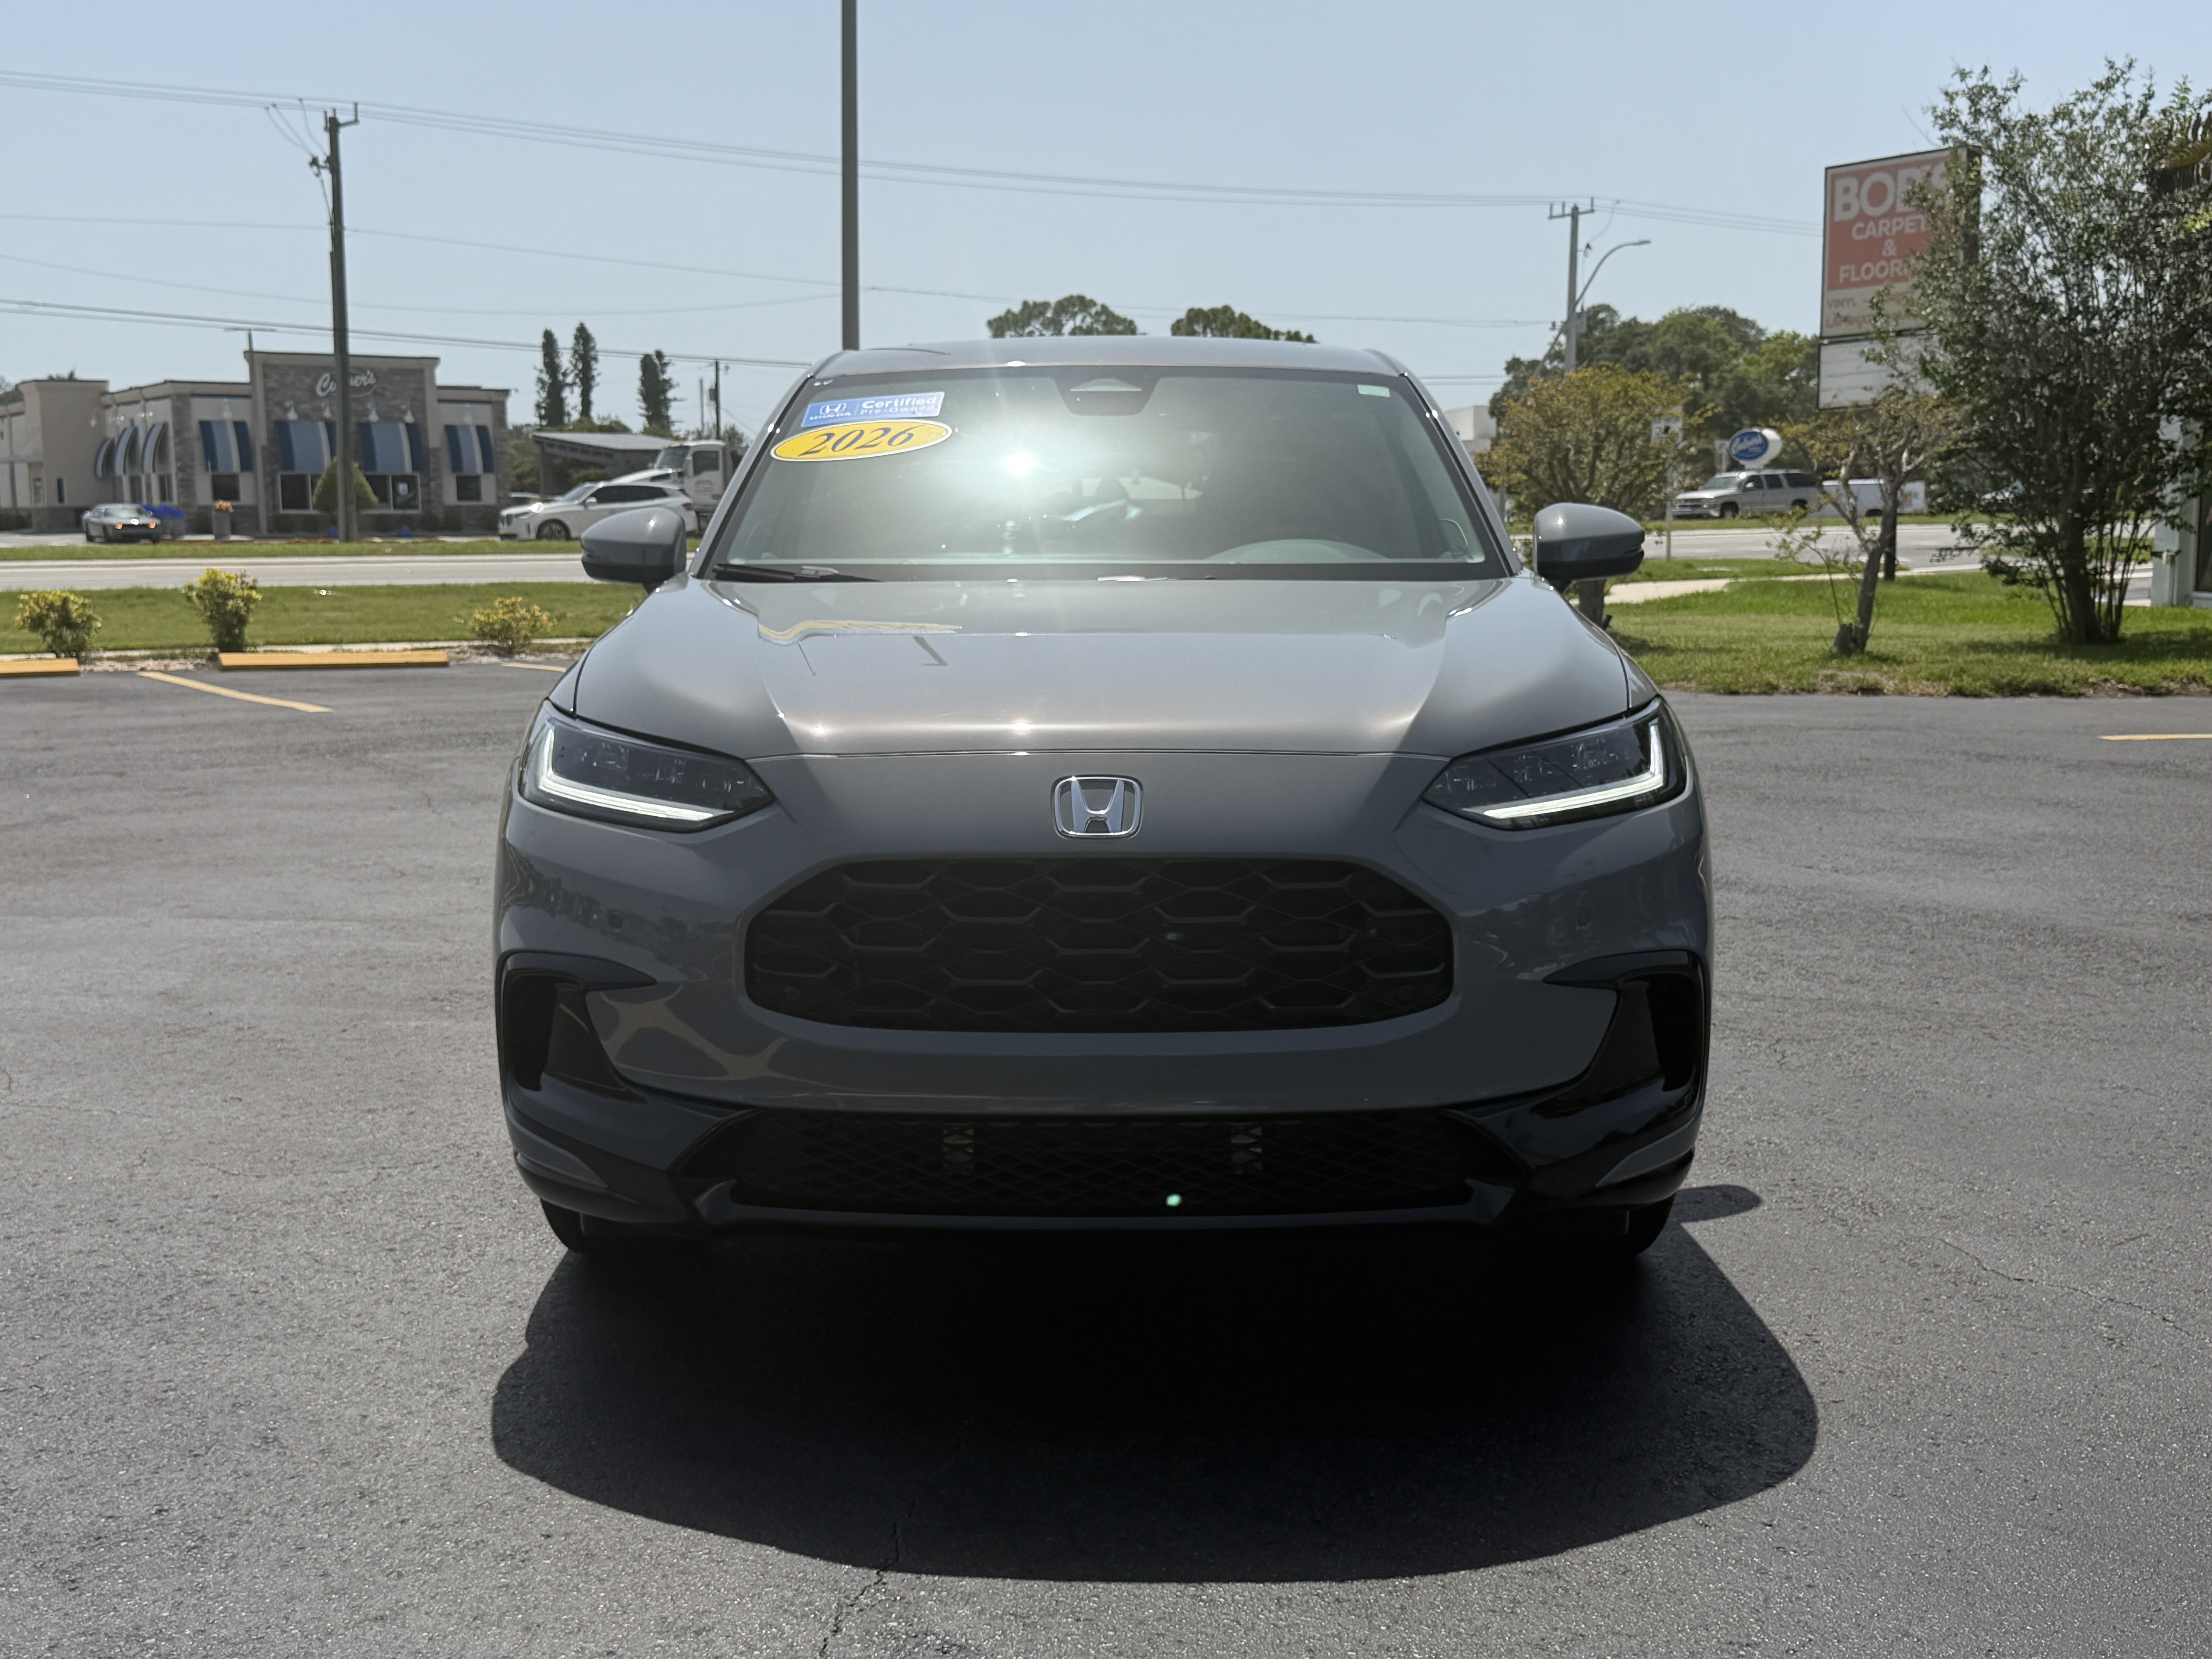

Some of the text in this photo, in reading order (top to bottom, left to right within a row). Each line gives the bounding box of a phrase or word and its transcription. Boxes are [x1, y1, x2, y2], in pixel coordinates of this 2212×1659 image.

[1851, 215, 1927, 240] CARPET
[1882, 239, 1897, 257] &
[860, 405, 935, 415] Pre-Owned
[862, 396, 936, 409] Certified
[799, 425, 926, 457] 2026
